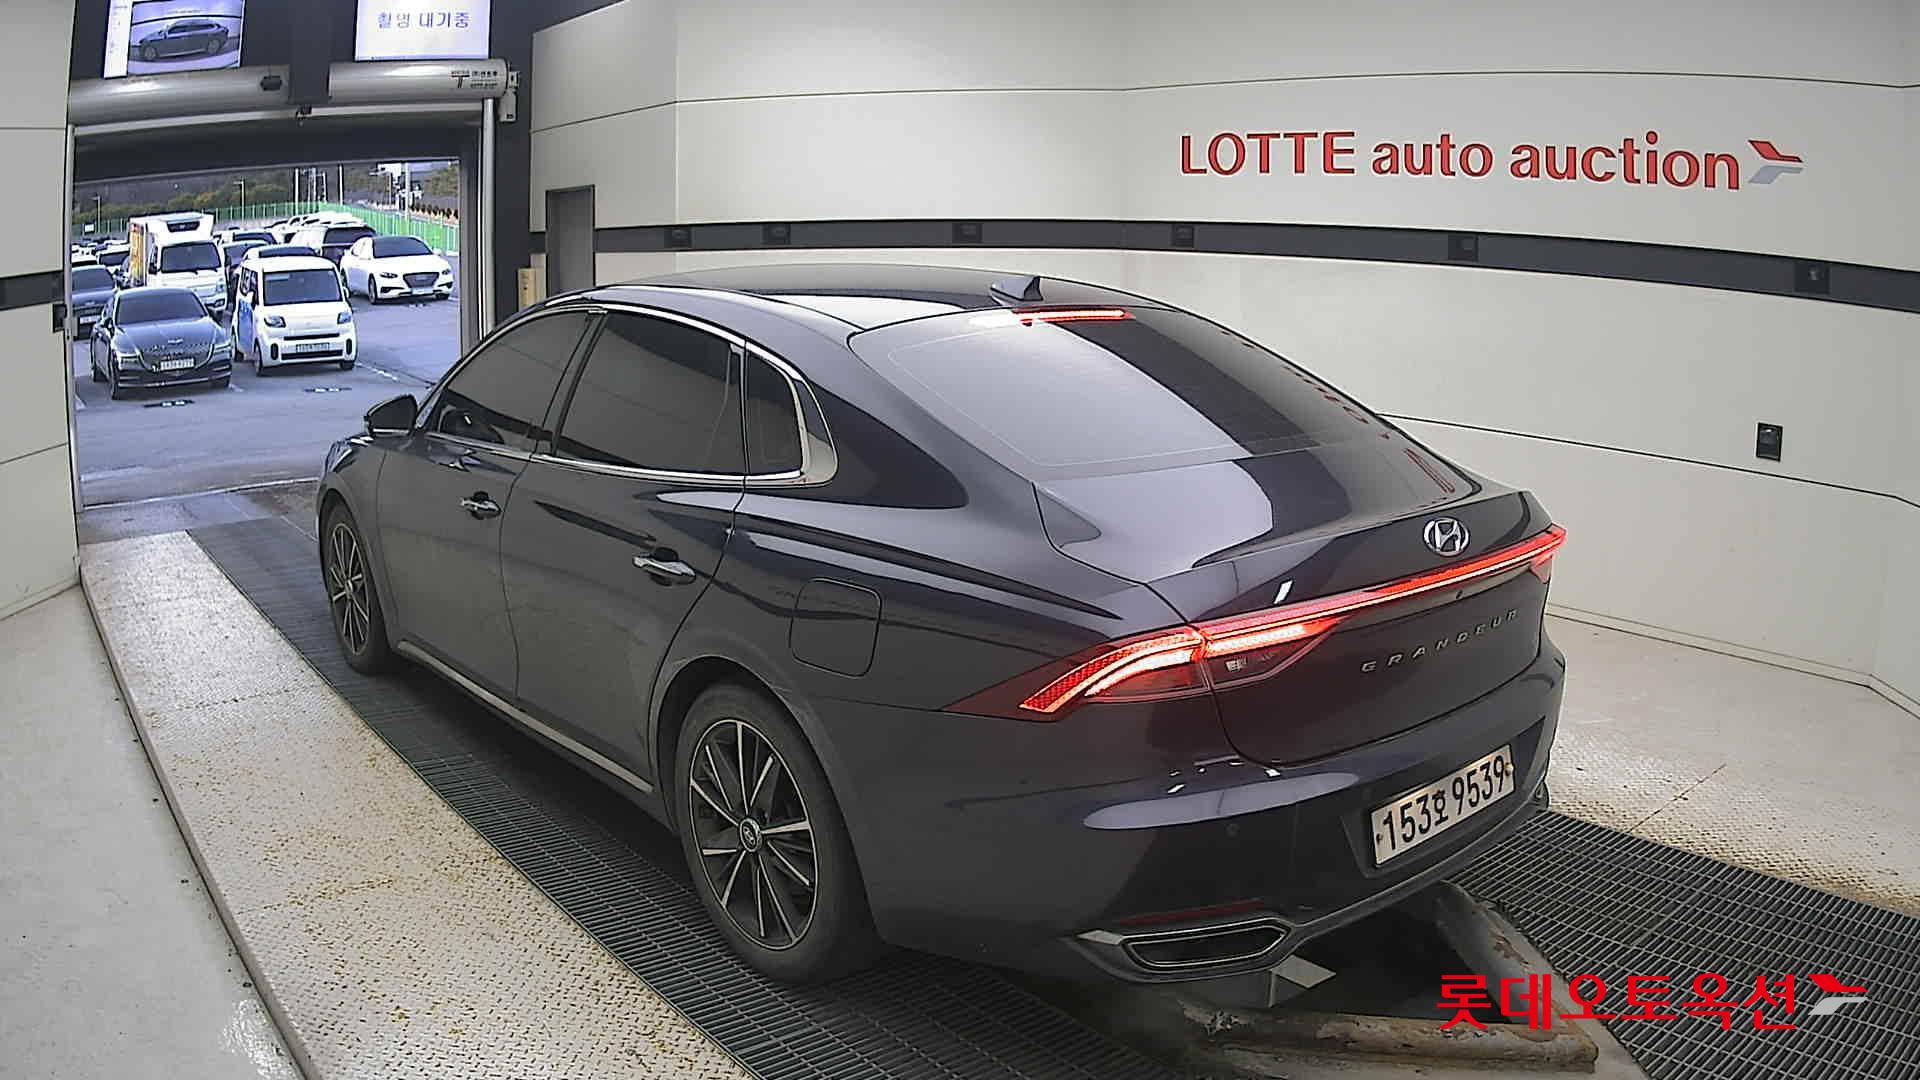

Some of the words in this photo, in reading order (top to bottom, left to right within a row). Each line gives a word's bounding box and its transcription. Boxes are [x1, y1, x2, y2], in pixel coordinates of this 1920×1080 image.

[419, 11, 471, 29] 대기중
[1180, 131, 1357, 176] LOTTE
[1371, 133, 1494, 178] auto
[1509, 131, 1740, 190] auction
[1361, 608, 1519, 673] GRANDEUR
